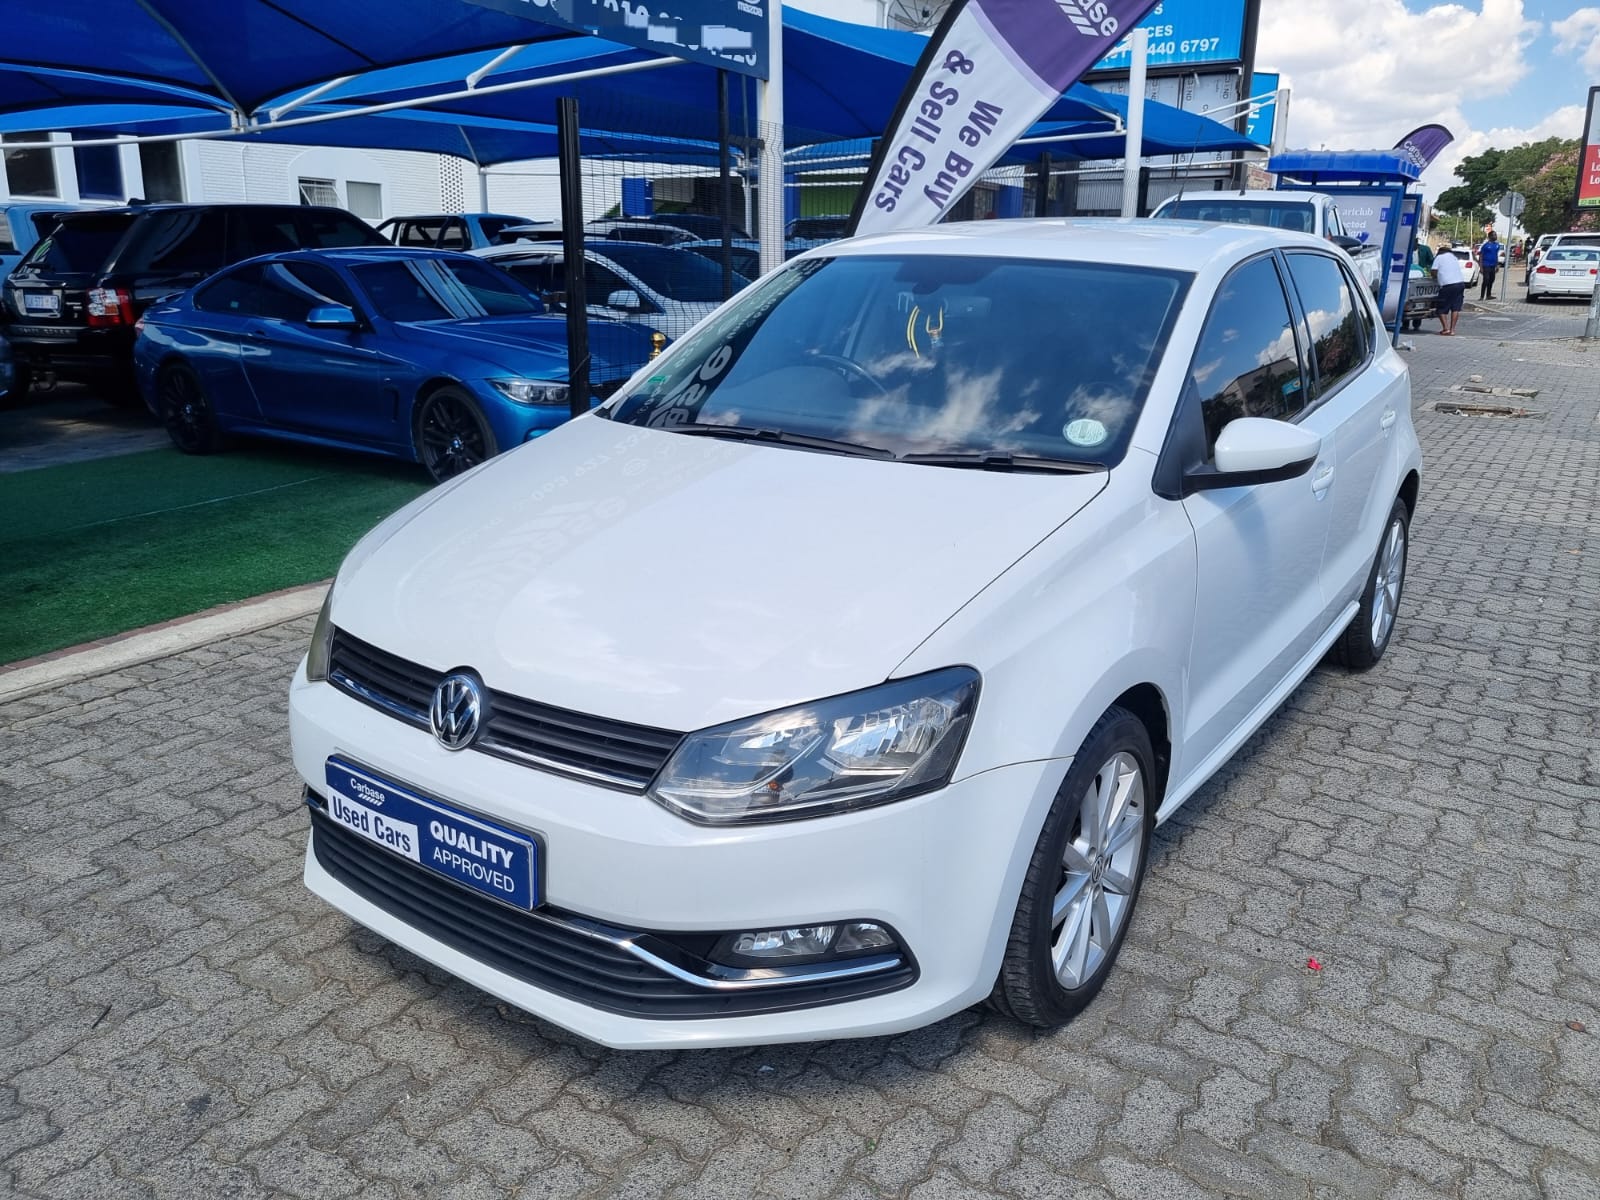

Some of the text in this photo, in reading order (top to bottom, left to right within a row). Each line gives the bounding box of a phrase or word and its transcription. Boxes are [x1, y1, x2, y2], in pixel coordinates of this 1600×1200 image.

[1180, 37, 1220, 54] 6797
[875, 49, 975, 213] & Sell Cars
[923, 100, 1004, 210] We Buy
[350, 777, 386, 803] Carbase
[332, 795, 412, 853] Used Cars
[429, 820, 515, 870] QUALITY
[432, 846, 516, 894] APPROVED
